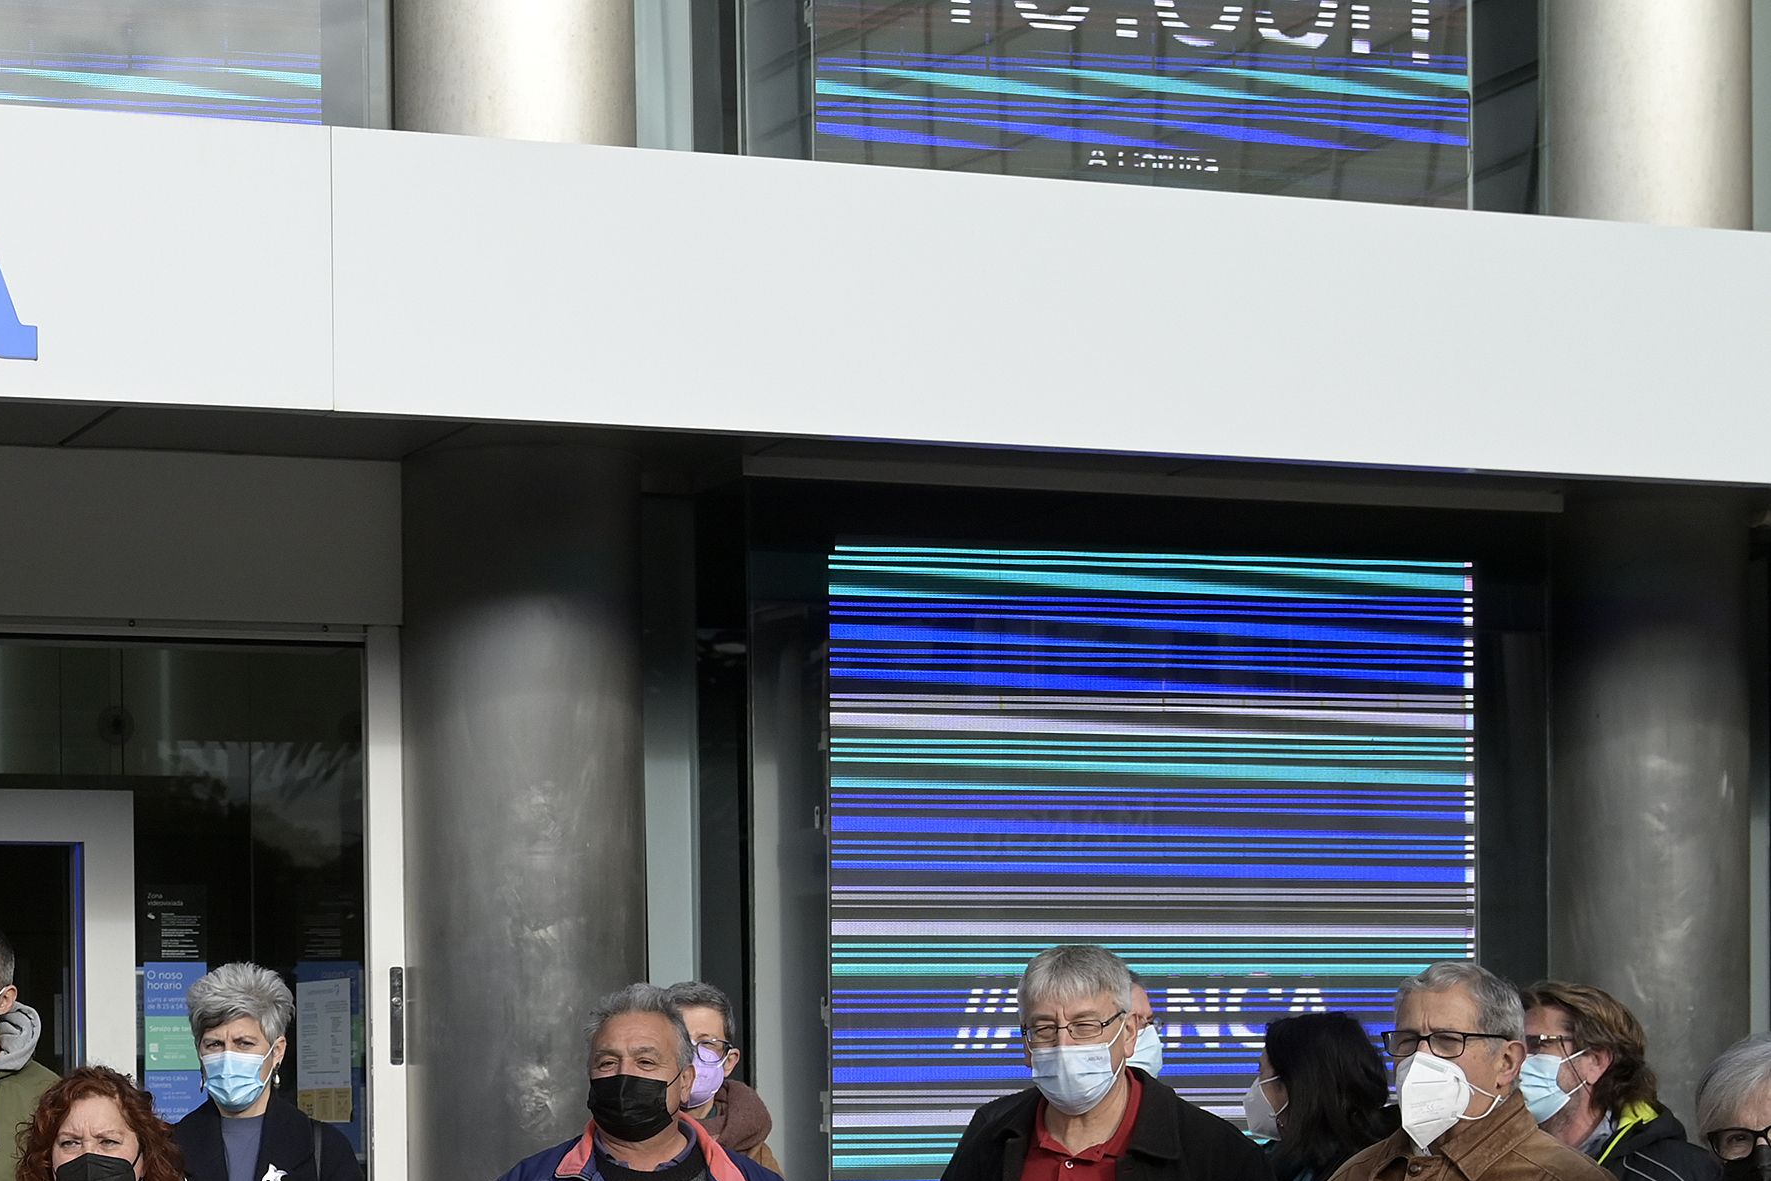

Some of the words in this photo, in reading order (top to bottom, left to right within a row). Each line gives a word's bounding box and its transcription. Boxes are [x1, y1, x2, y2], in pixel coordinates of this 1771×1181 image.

[147, 970, 156, 980] O
[158, 971, 183, 980] noso
[147, 980, 182, 990] horario
